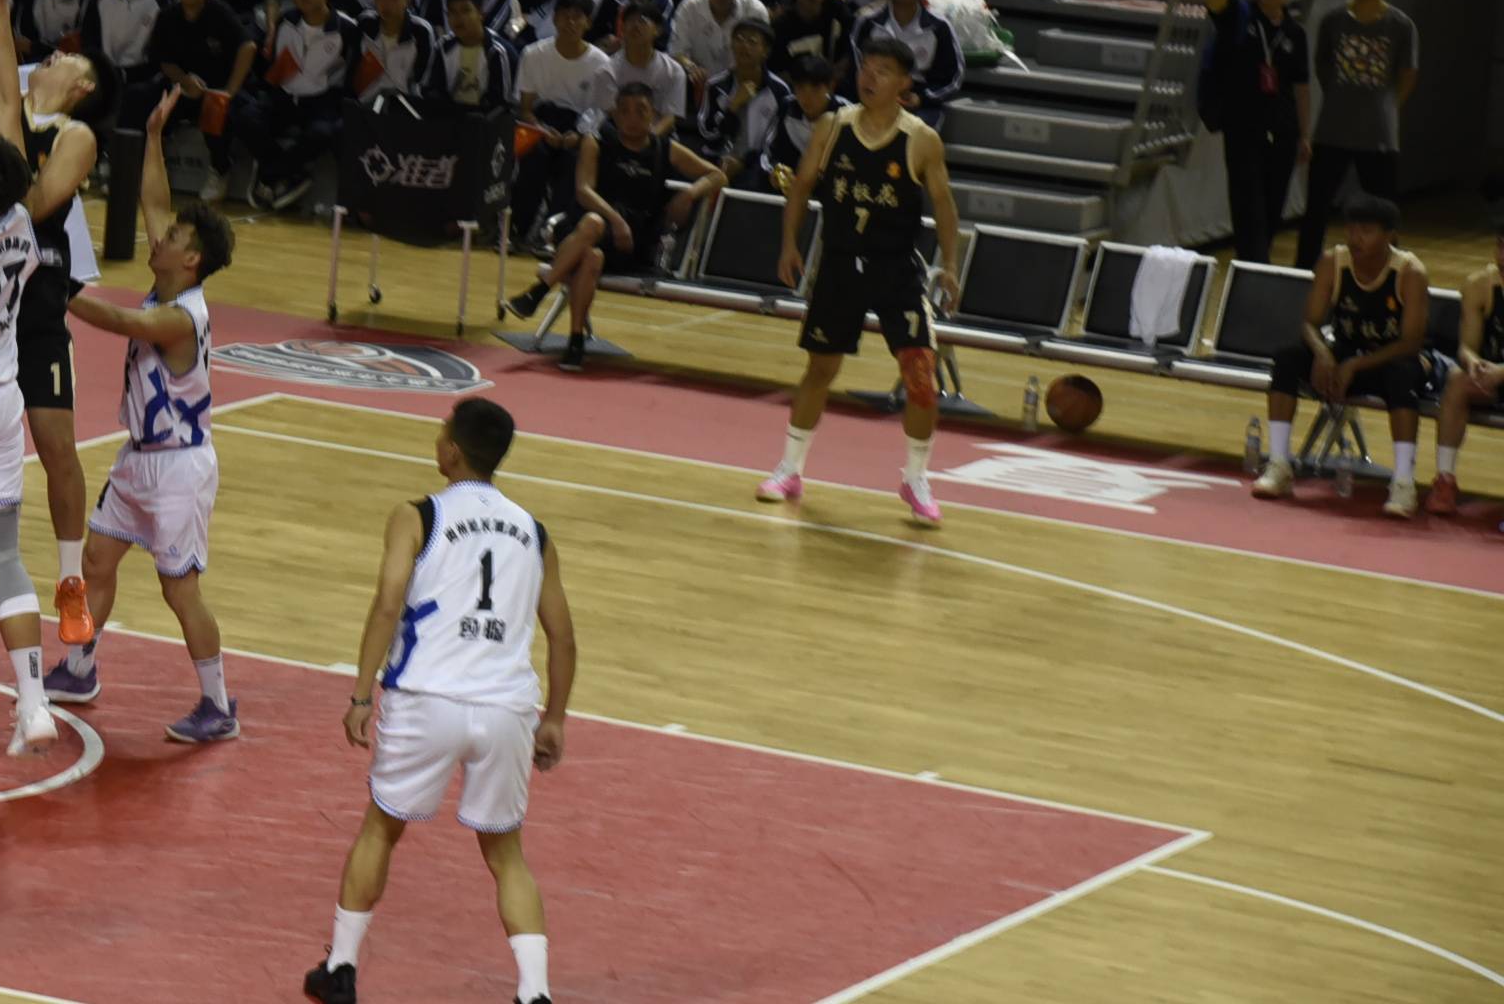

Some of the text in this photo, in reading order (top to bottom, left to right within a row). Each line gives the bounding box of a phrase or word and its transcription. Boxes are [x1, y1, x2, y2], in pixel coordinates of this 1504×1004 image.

[853, 205, 871, 236] 7
[903, 309, 921, 340] 7
[49, 361, 63, 397] 1
[477, 548, 493, 611] 1
